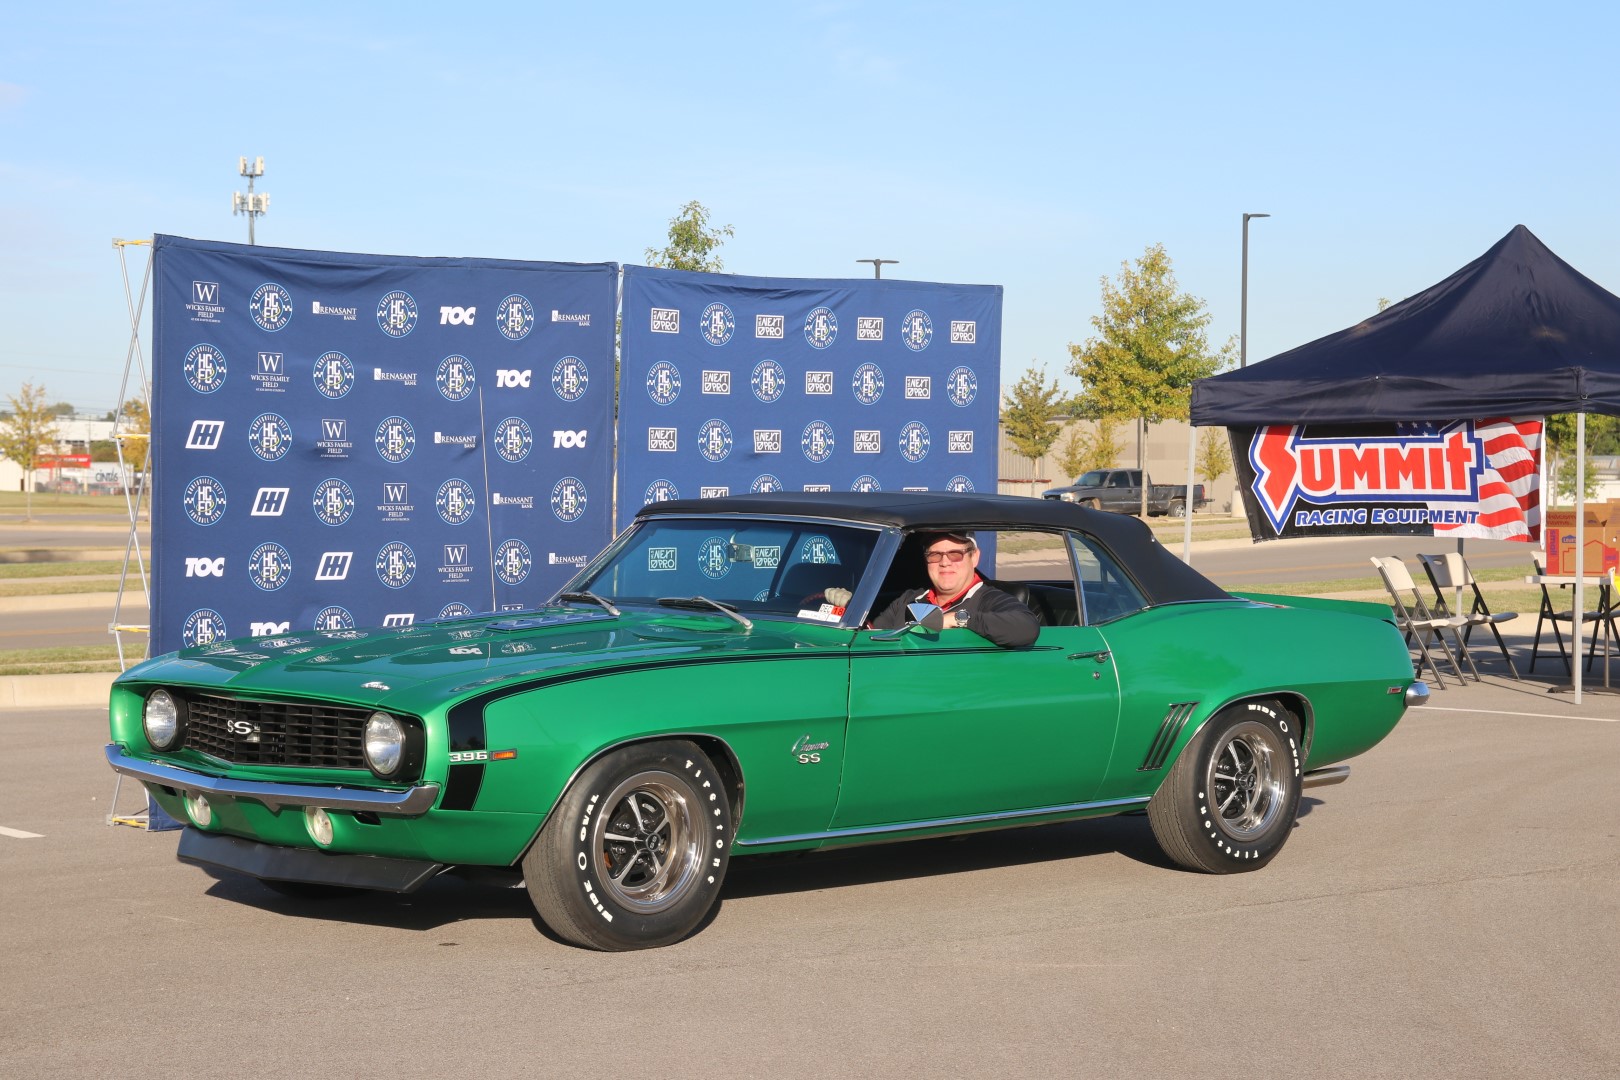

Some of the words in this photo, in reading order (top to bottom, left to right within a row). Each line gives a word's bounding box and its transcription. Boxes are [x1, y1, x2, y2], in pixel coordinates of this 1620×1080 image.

[195, 284, 215, 302] W
[186, 304, 203, 312] WICKS
[204, 305, 225, 313] FAMILY
[198, 311, 214, 319] FIELD
[440, 306, 476, 325] TOC
[657, 311, 677, 321] NEXT
[763, 318, 782, 328] NEXT
[864, 320, 881, 328] NEXT
[957, 324, 974, 332] NEXT
[260, 354, 280, 372] W
[496, 369, 531, 388] TOC
[709, 373, 728, 383] NEXT
[813, 374, 831, 383] NEXT
[911, 379, 928, 387] NEXT
[324, 422, 344, 438] W
[655, 430, 675, 439] NEXT
[442, 435, 476, 443] RENASANT
[553, 430, 587, 448] TOC
[760, 432, 780, 441] NEXT
[860, 433, 878, 442] NEXT
[954, 433, 971, 442] NEXT
[386, 486, 405, 502] W
[1296, 508, 1367, 526] RACING
[1372, 508, 1480, 525] EQUIPMENT
[447, 547, 465, 563] W
[657, 550, 674, 559] NEXT
[760, 549, 779, 557] NEXT
[185, 557, 225, 577] TOC
[820, 605, 832, 614] DEC
[833, 606, 843, 616] 18
[228, 720, 252, 734] SS
[1248, 704, 1276, 719] WIDE
[1279, 720, 1288, 733] O
[1289, 738, 1300, 777] OVAL
[448, 751, 488, 762] 396
[798, 753, 820, 764] SS
[580, 794, 599, 841] OVAL
[578, 852, 587, 870] O
[584, 880, 613, 922] WIDE
